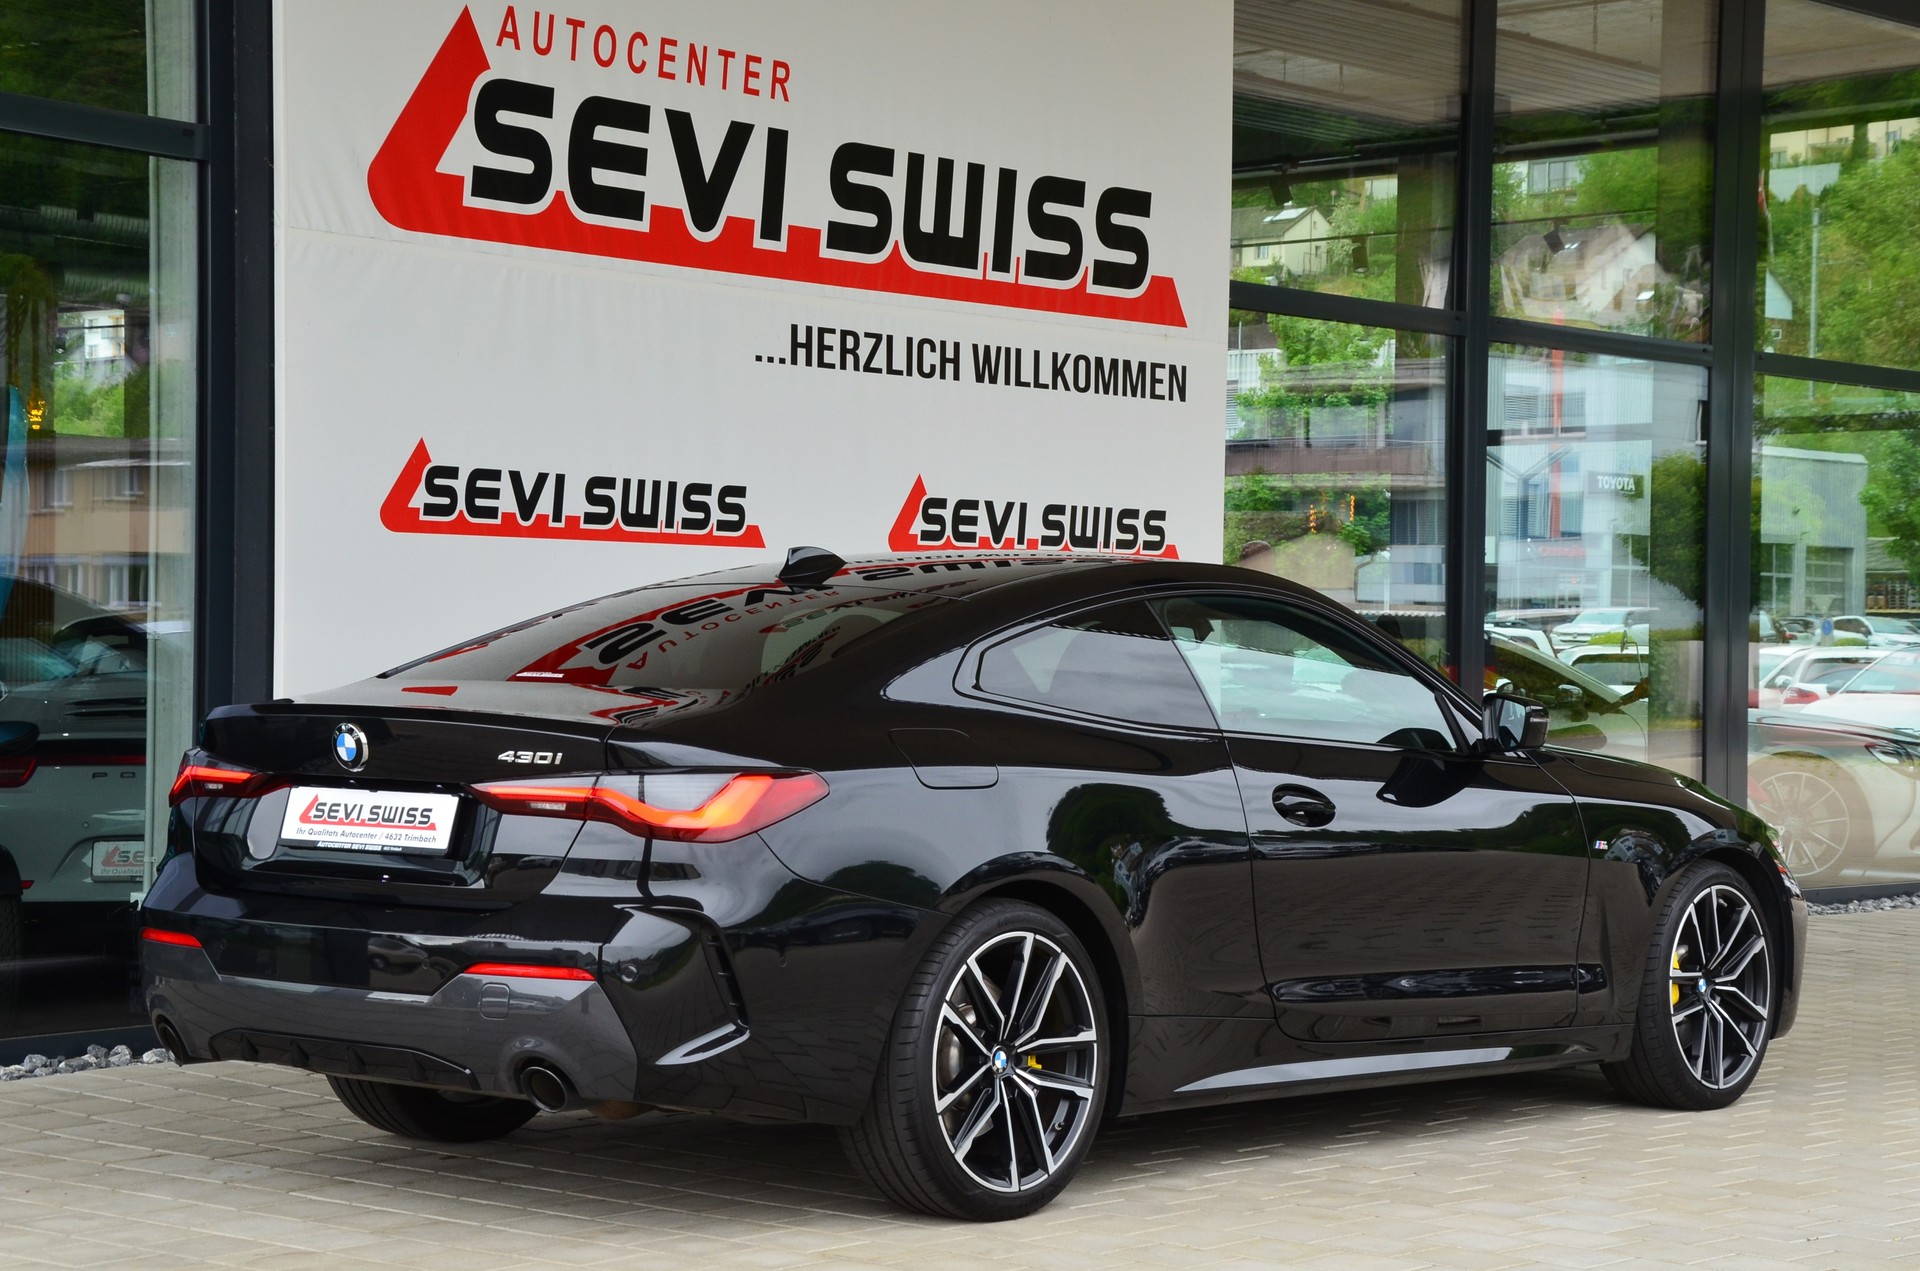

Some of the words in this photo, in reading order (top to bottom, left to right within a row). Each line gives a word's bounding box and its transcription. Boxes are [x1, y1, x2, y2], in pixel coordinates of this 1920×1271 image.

[496, 5, 791, 103] AUTOCENTER
[471, 78, 789, 243] SEVI
[826, 142, 1153, 290] SWISS
[755, 323, 961, 383] ...HERZLICH
[972, 344, 1188, 403] WILLKOMMEN
[422, 465, 565, 527] SEVI
[583, 475, 748, 534] SWISS
[1597, 475, 1636, 492] TOYOTA
[920, 496, 1028, 549] SEVI
[1041, 503, 1167, 552] SWISS
[312, 802, 364, 822] SEVI
[367, 805, 434, 826] SWISS
[340, 830, 379, 841] Autocenter
[385, 832, 403, 841] 4632
[404, 833, 437, 844] Trimbach
[116, 850, 145, 863] SE
